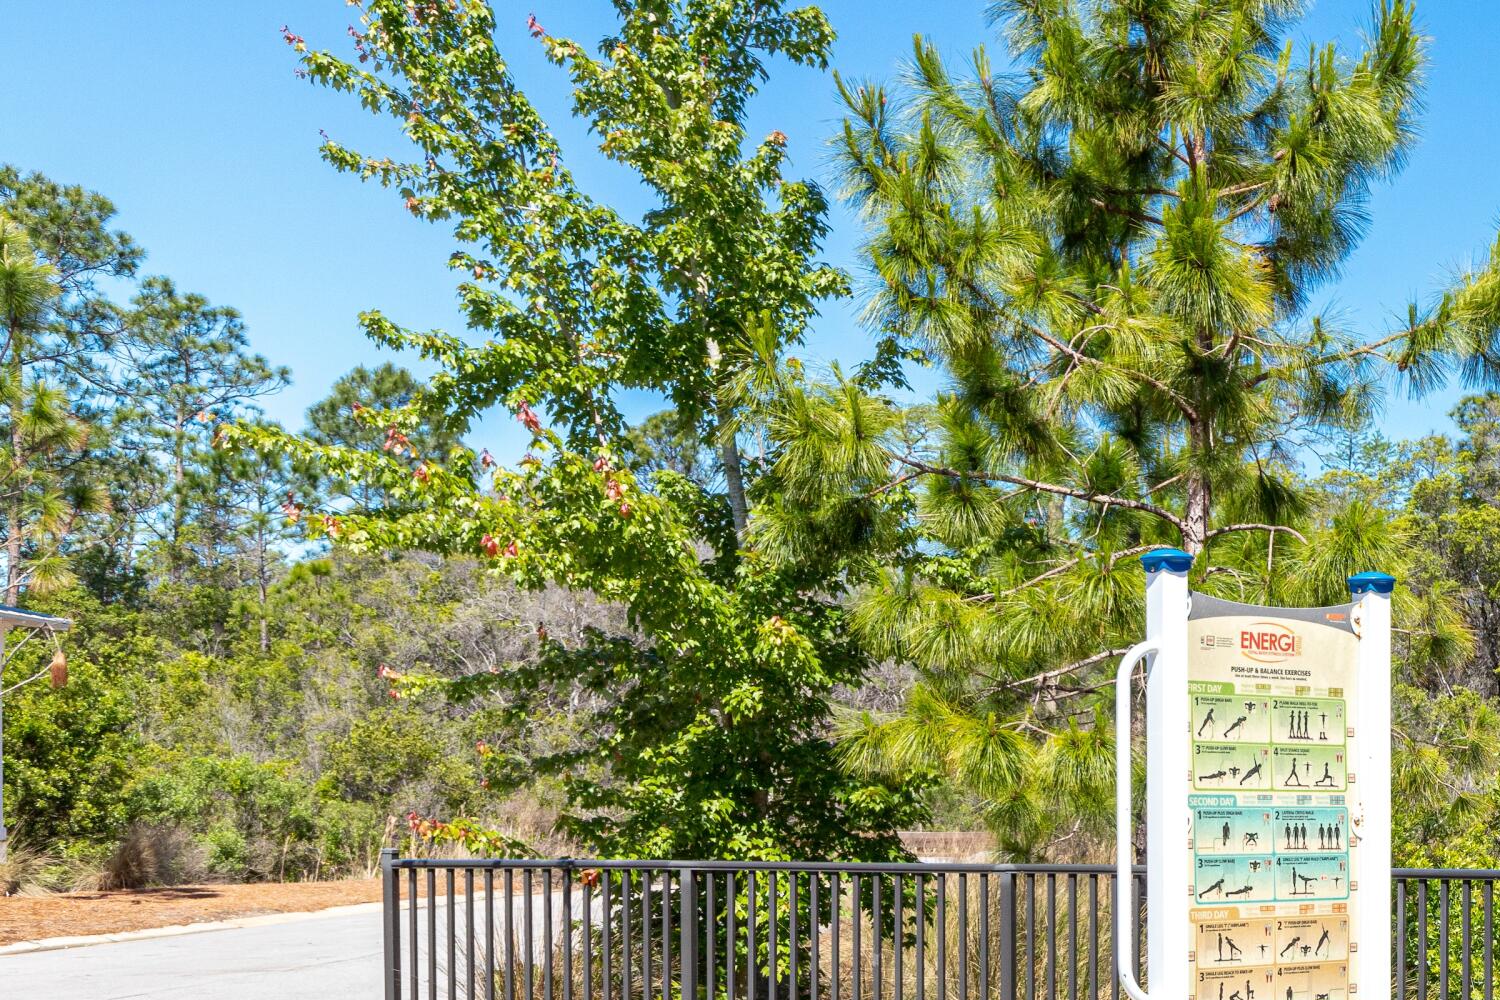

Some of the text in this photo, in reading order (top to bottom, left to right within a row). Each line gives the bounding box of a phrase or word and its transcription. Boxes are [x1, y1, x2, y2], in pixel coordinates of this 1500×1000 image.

[1241, 631, 1295, 652] ENERGI
[1260, 668, 1283, 676] BALANCE
[1284, 669, 1311, 677] EXERCISES
[1207, 685, 1223, 693] DAY
[1195, 697, 1199, 706] 1
[1273, 700, 1278, 709] 2
[1195, 745, 1201, 755] 3
[1273, 747, 1279, 756] 4
[1189, 797, 1234, 807] SECOND DAY
[1197, 810, 1202, 820] 1
[1275, 811, 1280, 820] 2
[1198, 859, 1203, 868] 3
[1276, 857, 1282, 866] 4
[1191, 911, 1229, 920] THIRD DAY
[1200, 924, 1204, 933] 1
[1277, 921, 1282, 930] 2
[1277, 968, 1283, 976] 4
[1200, 972, 1205, 982] 3
